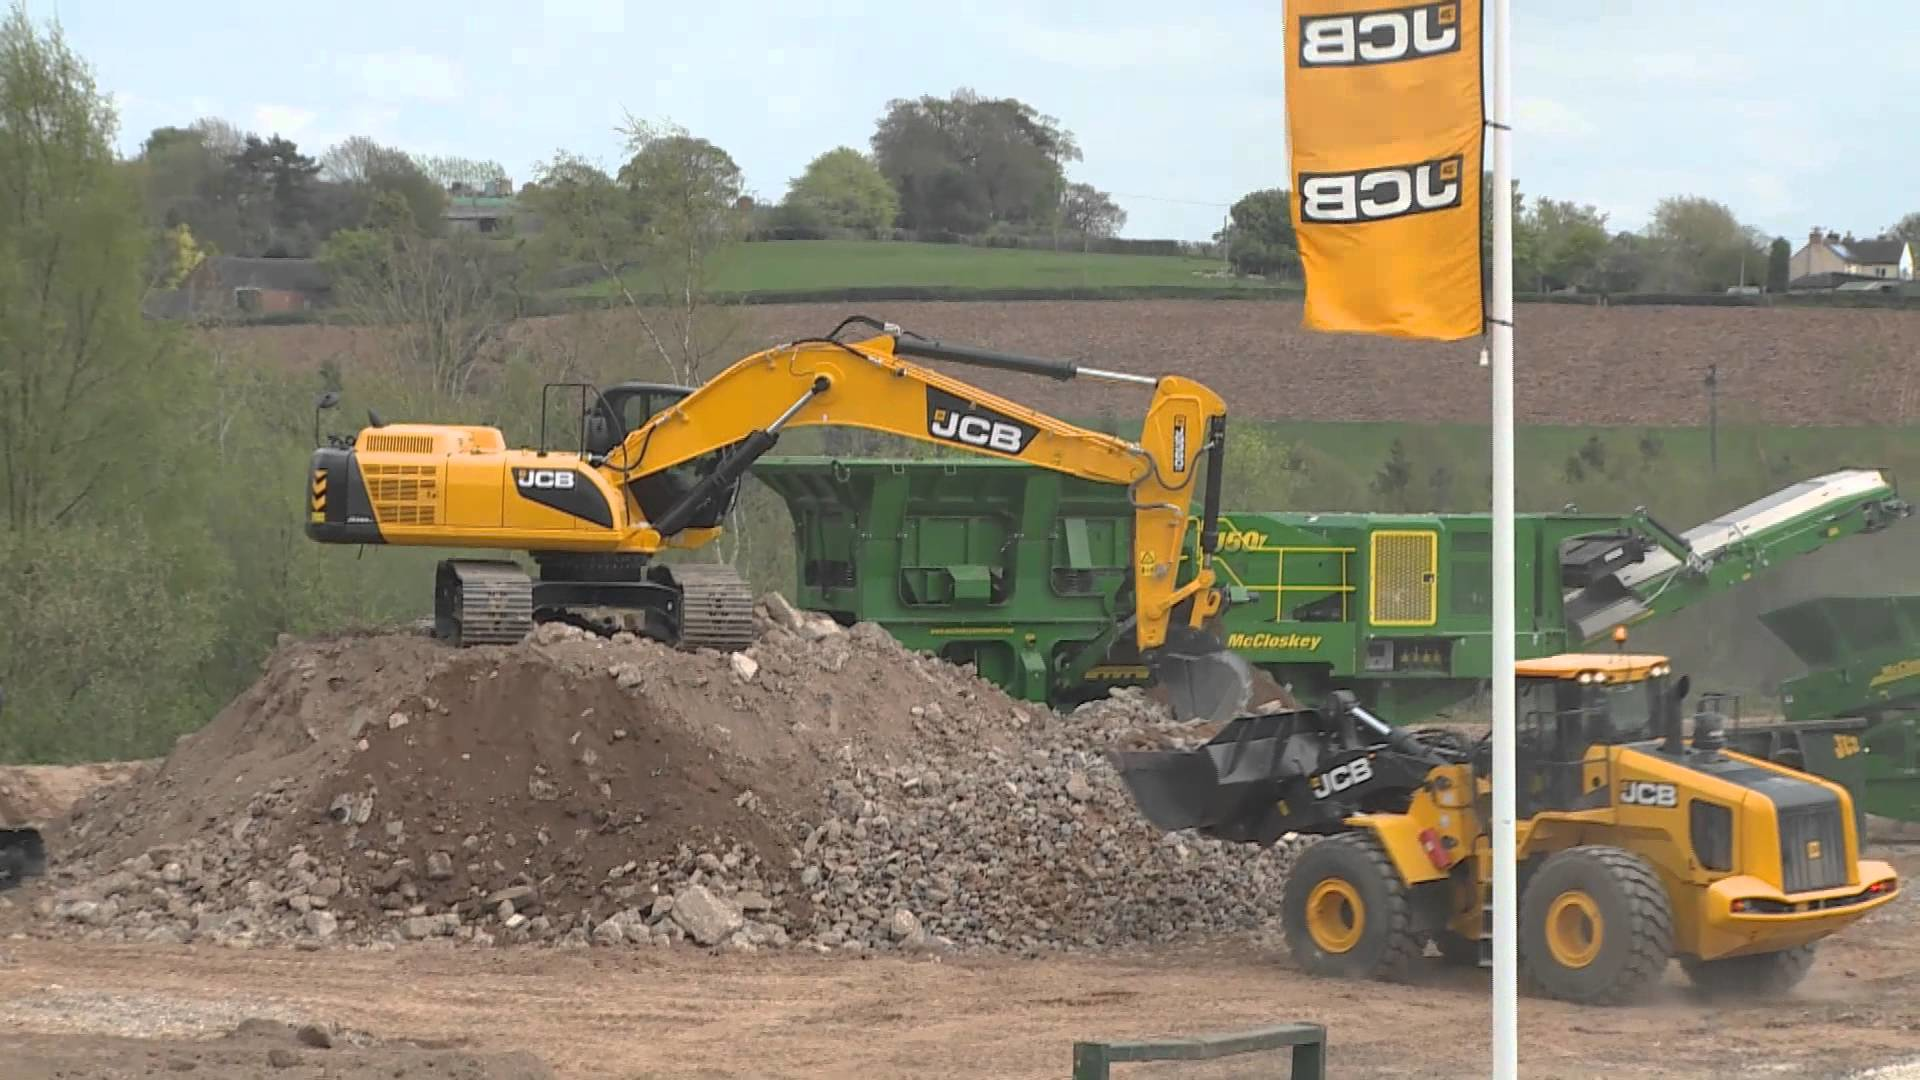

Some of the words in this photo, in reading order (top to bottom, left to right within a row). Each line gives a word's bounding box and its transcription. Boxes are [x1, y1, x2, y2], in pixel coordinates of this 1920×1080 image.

[931, 411, 1022, 453] JCB
[518, 469, 575, 489] JCB
[1227, 633, 1322, 651] McCloskey
[1313, 757, 1374, 799] JCB
[1620, 782, 1677, 808] JCB
